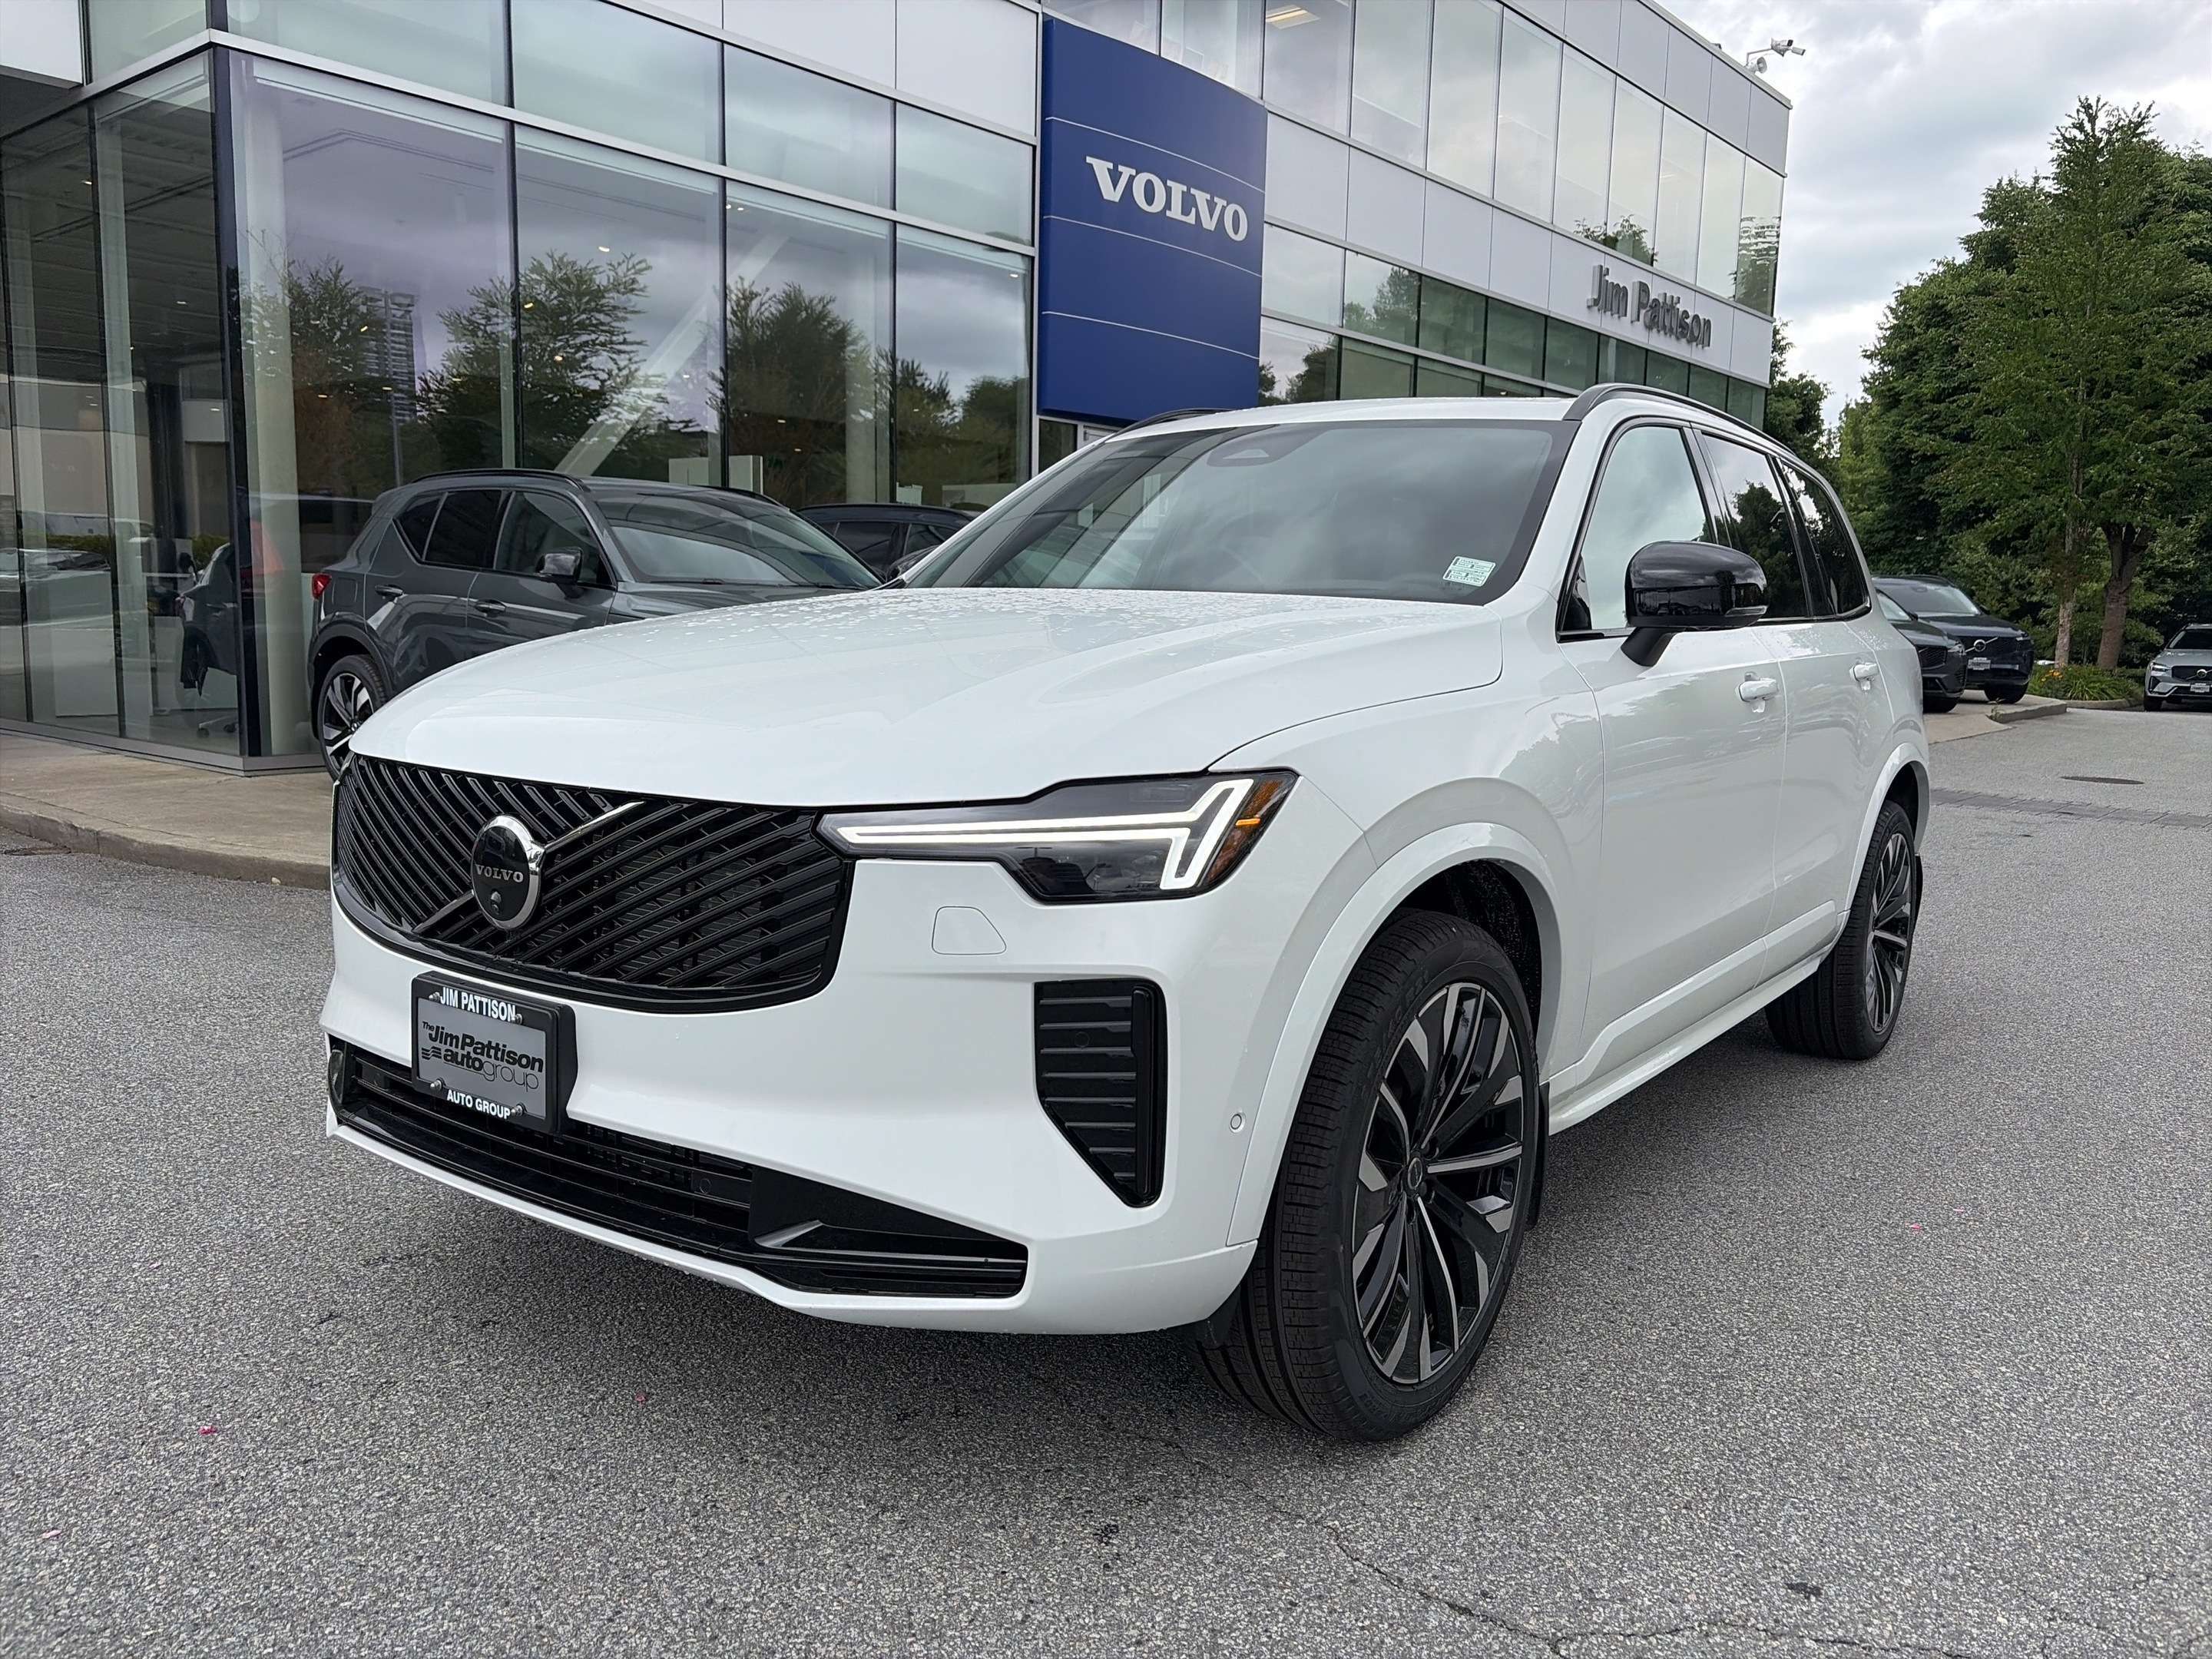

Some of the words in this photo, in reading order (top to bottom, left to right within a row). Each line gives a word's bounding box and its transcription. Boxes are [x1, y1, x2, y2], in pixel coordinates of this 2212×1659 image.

[1086, 156, 1247, 241] VOLVO
[1587, 264, 1628, 319] Jim
[1631, 280, 1712, 348] Pattison
[475, 864, 524, 883] VOLVO
[440, 986, 459, 1008] JIM
[461, 992, 515, 1022] PATTISON
[422, 1021, 435, 1031] The
[446, 1089, 473, 1108] AUTO
[475, 1098, 511, 1120] GROUP
